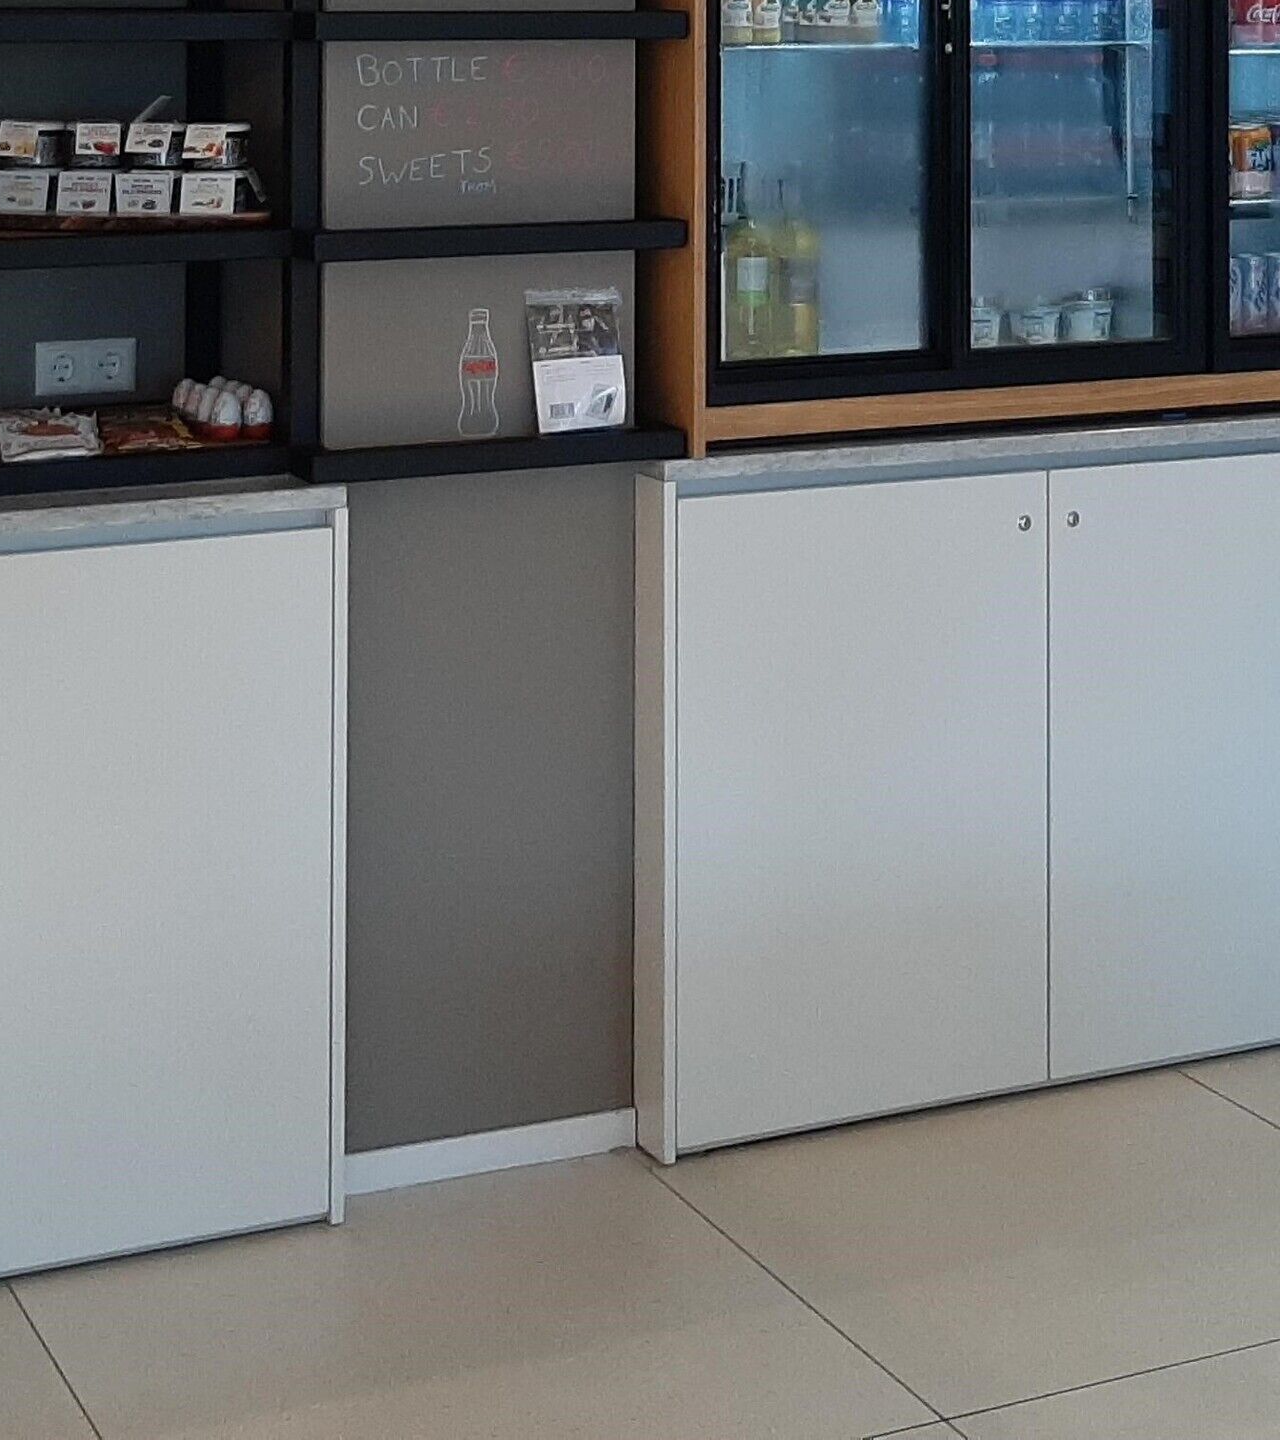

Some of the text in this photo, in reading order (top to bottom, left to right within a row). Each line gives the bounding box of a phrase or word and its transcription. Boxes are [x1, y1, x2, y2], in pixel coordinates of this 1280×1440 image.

[356, 54, 488, 87] BOTTLE
[357, 104, 418, 131] CAN
[358, 147, 493, 185] SWEETS
